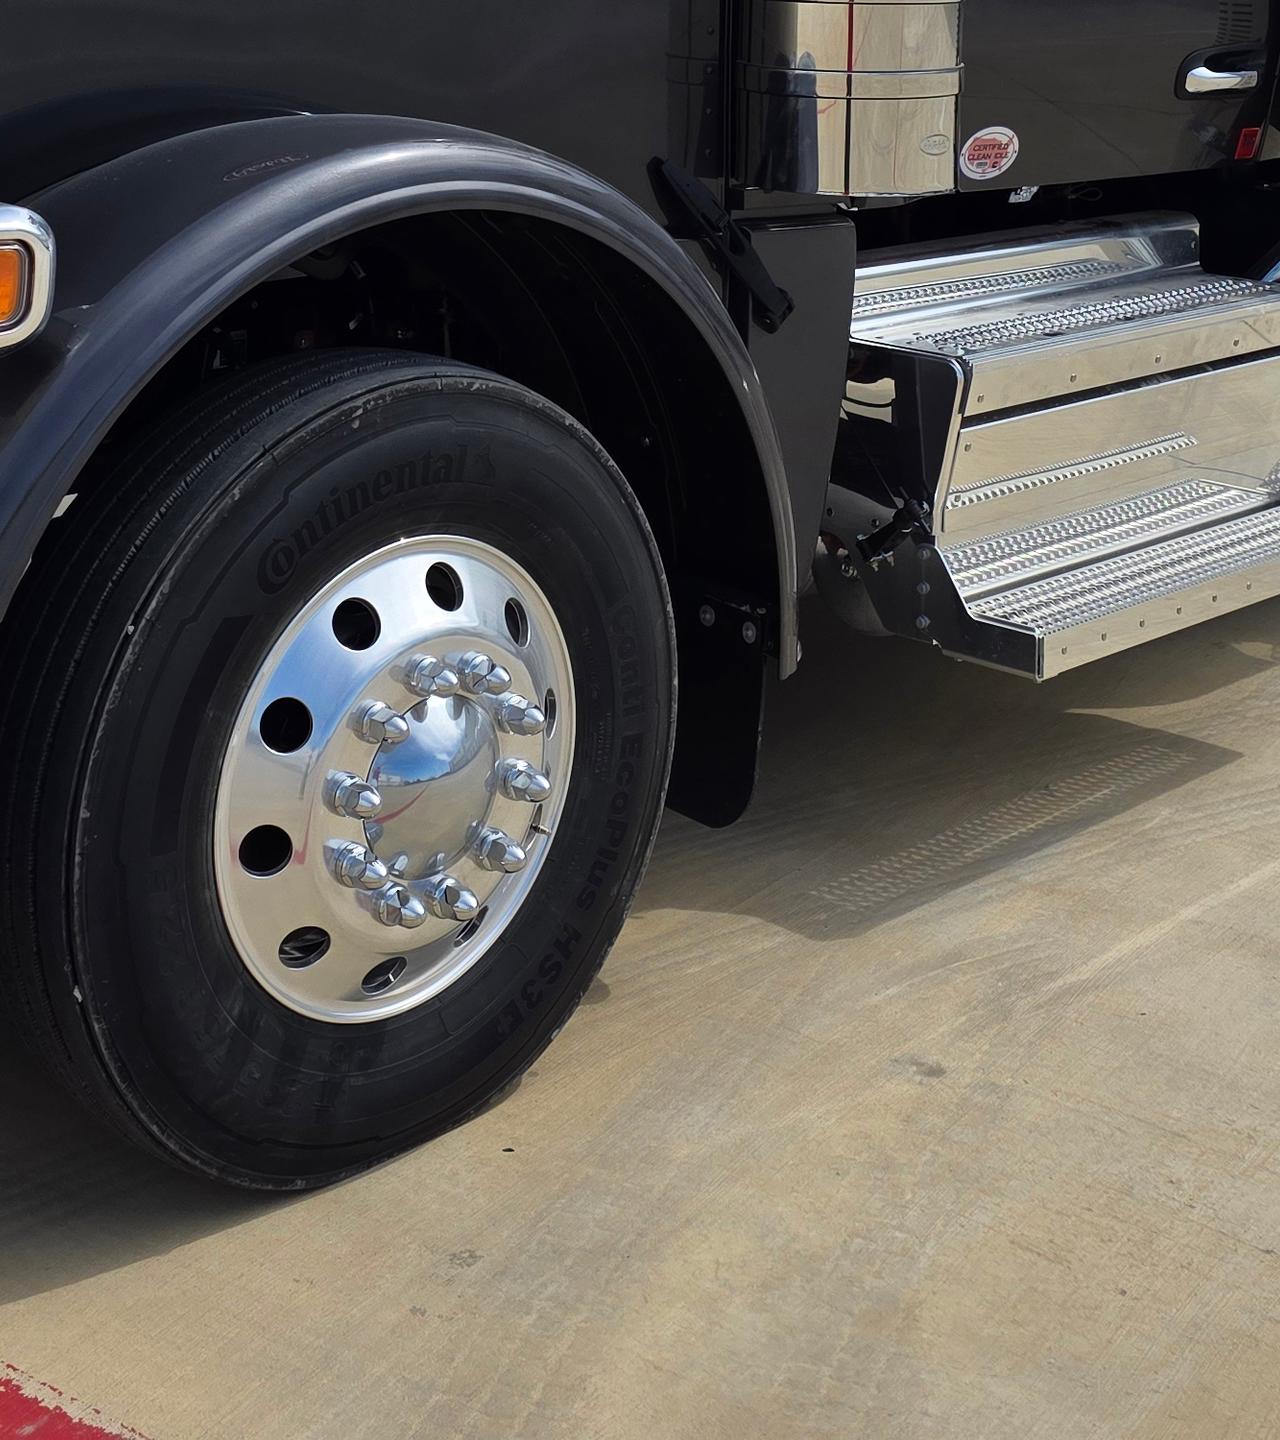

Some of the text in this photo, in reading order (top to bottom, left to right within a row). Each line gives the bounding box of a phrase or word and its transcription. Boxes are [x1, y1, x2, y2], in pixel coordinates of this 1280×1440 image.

[967, 151, 1010, 161] CLEAN IDLE
[973, 142, 1009, 151] CERTIFIED
[256, 442, 469, 596] Continental
[610, 599, 643, 718] Conti
